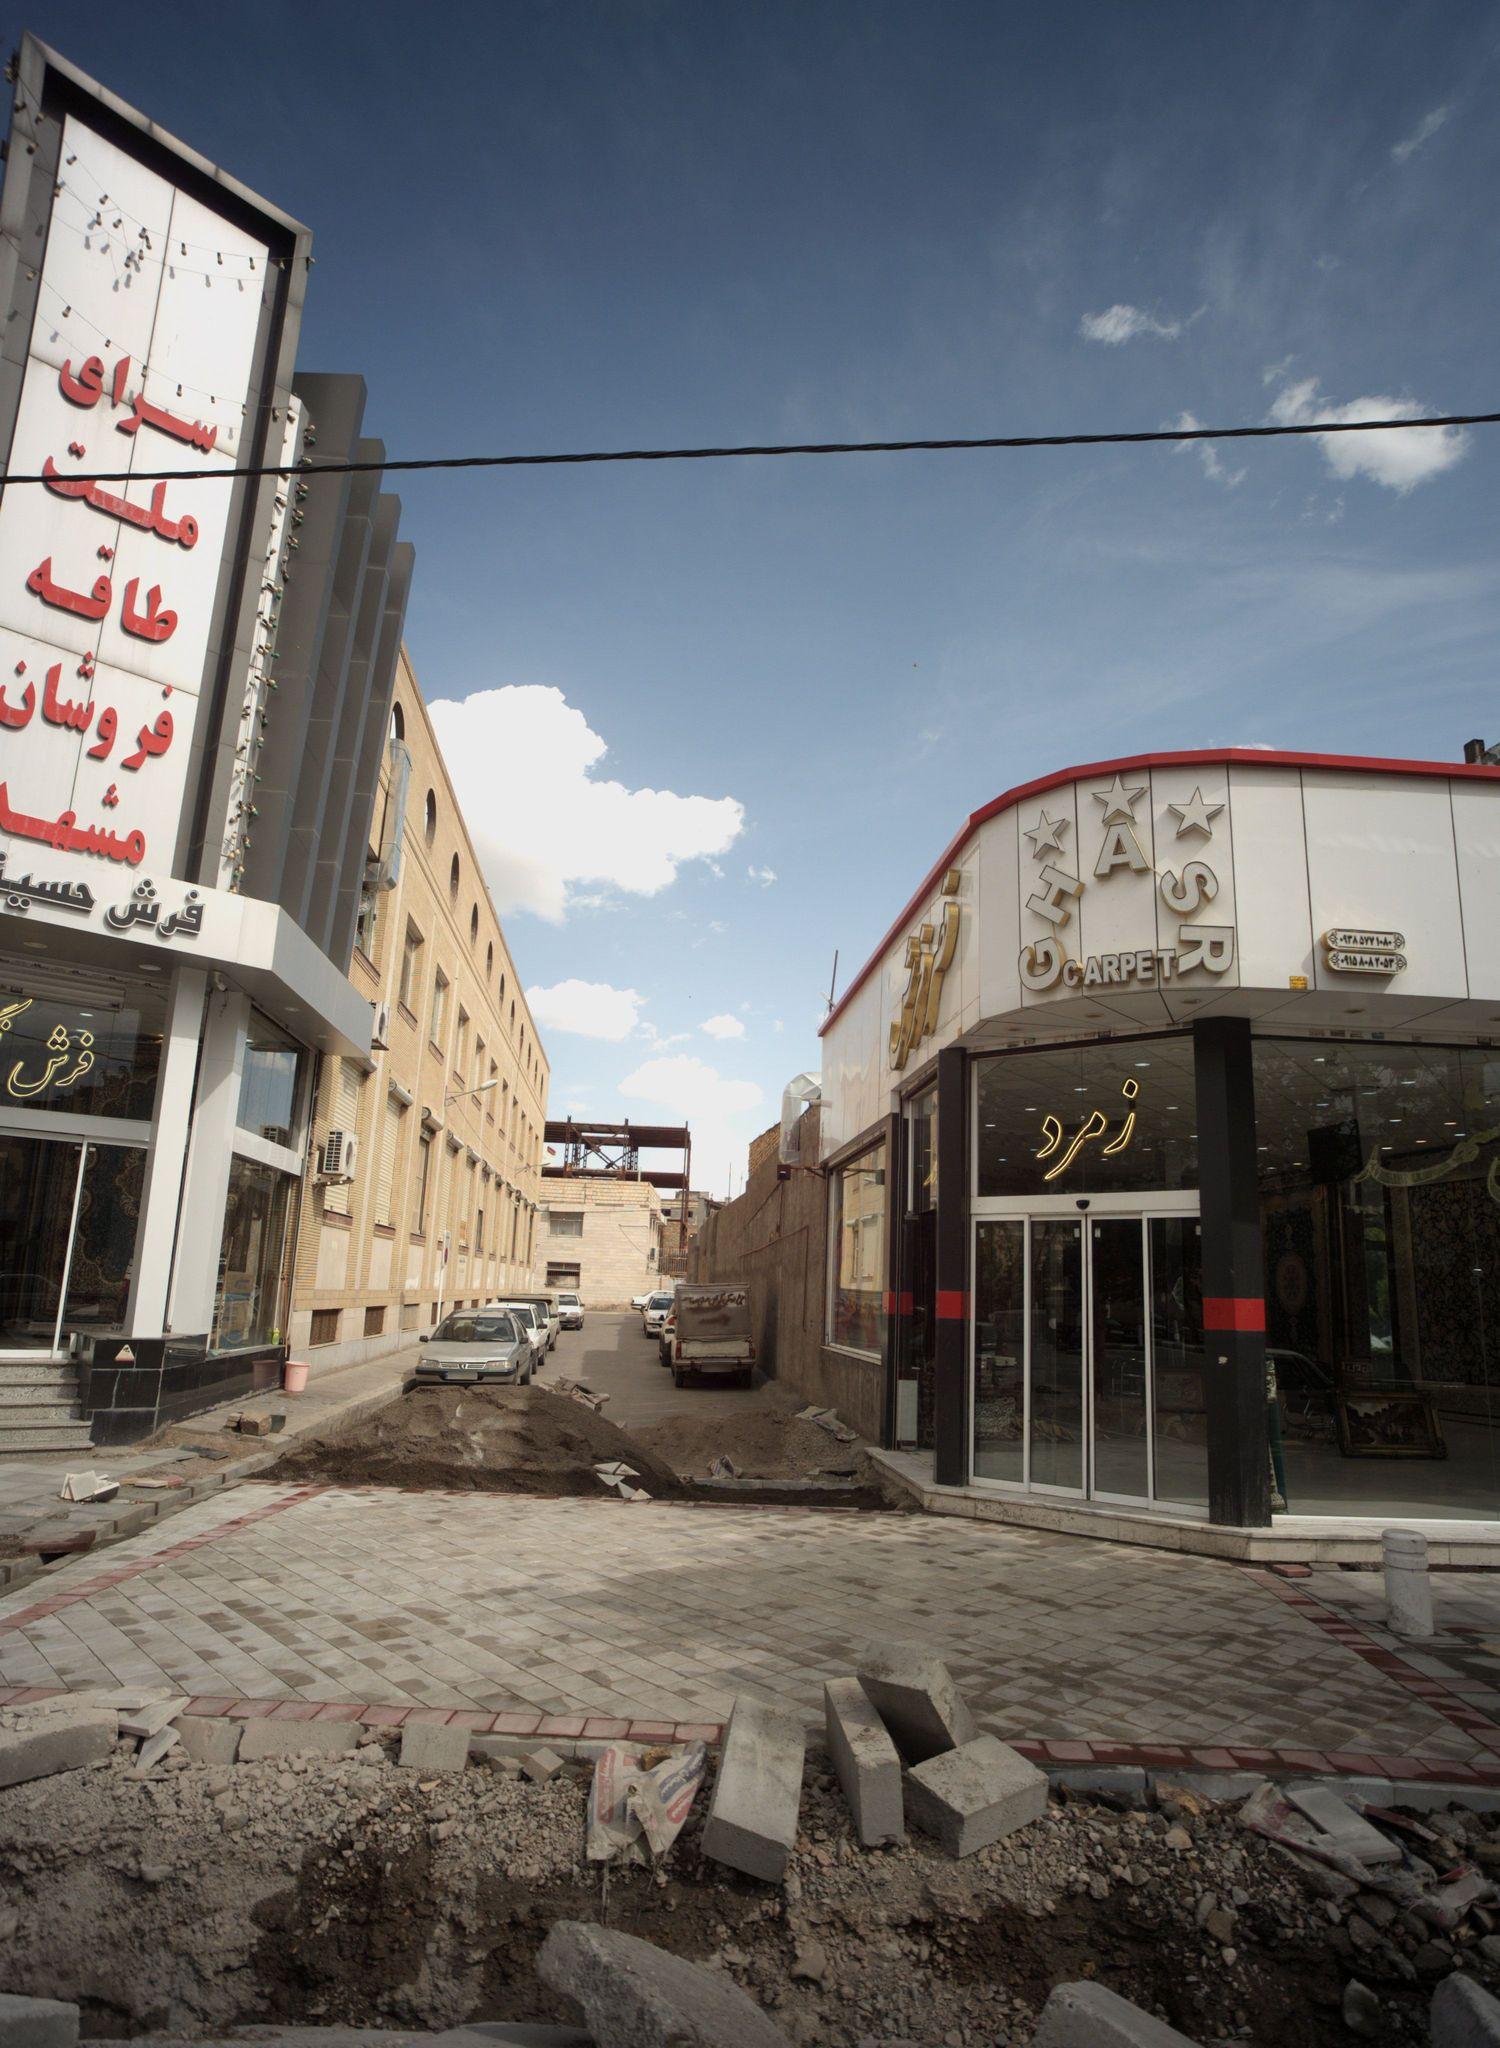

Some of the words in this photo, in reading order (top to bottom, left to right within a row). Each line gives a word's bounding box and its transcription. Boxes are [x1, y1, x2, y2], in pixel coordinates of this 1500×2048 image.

[60, 356, 218, 451] سرای
[0, 650, 174, 769] فروشان
[106, 878, 206, 936] فرش
[1062, 948, 1177, 988] CARPET
[7, 1023, 95, 1098] فرش
